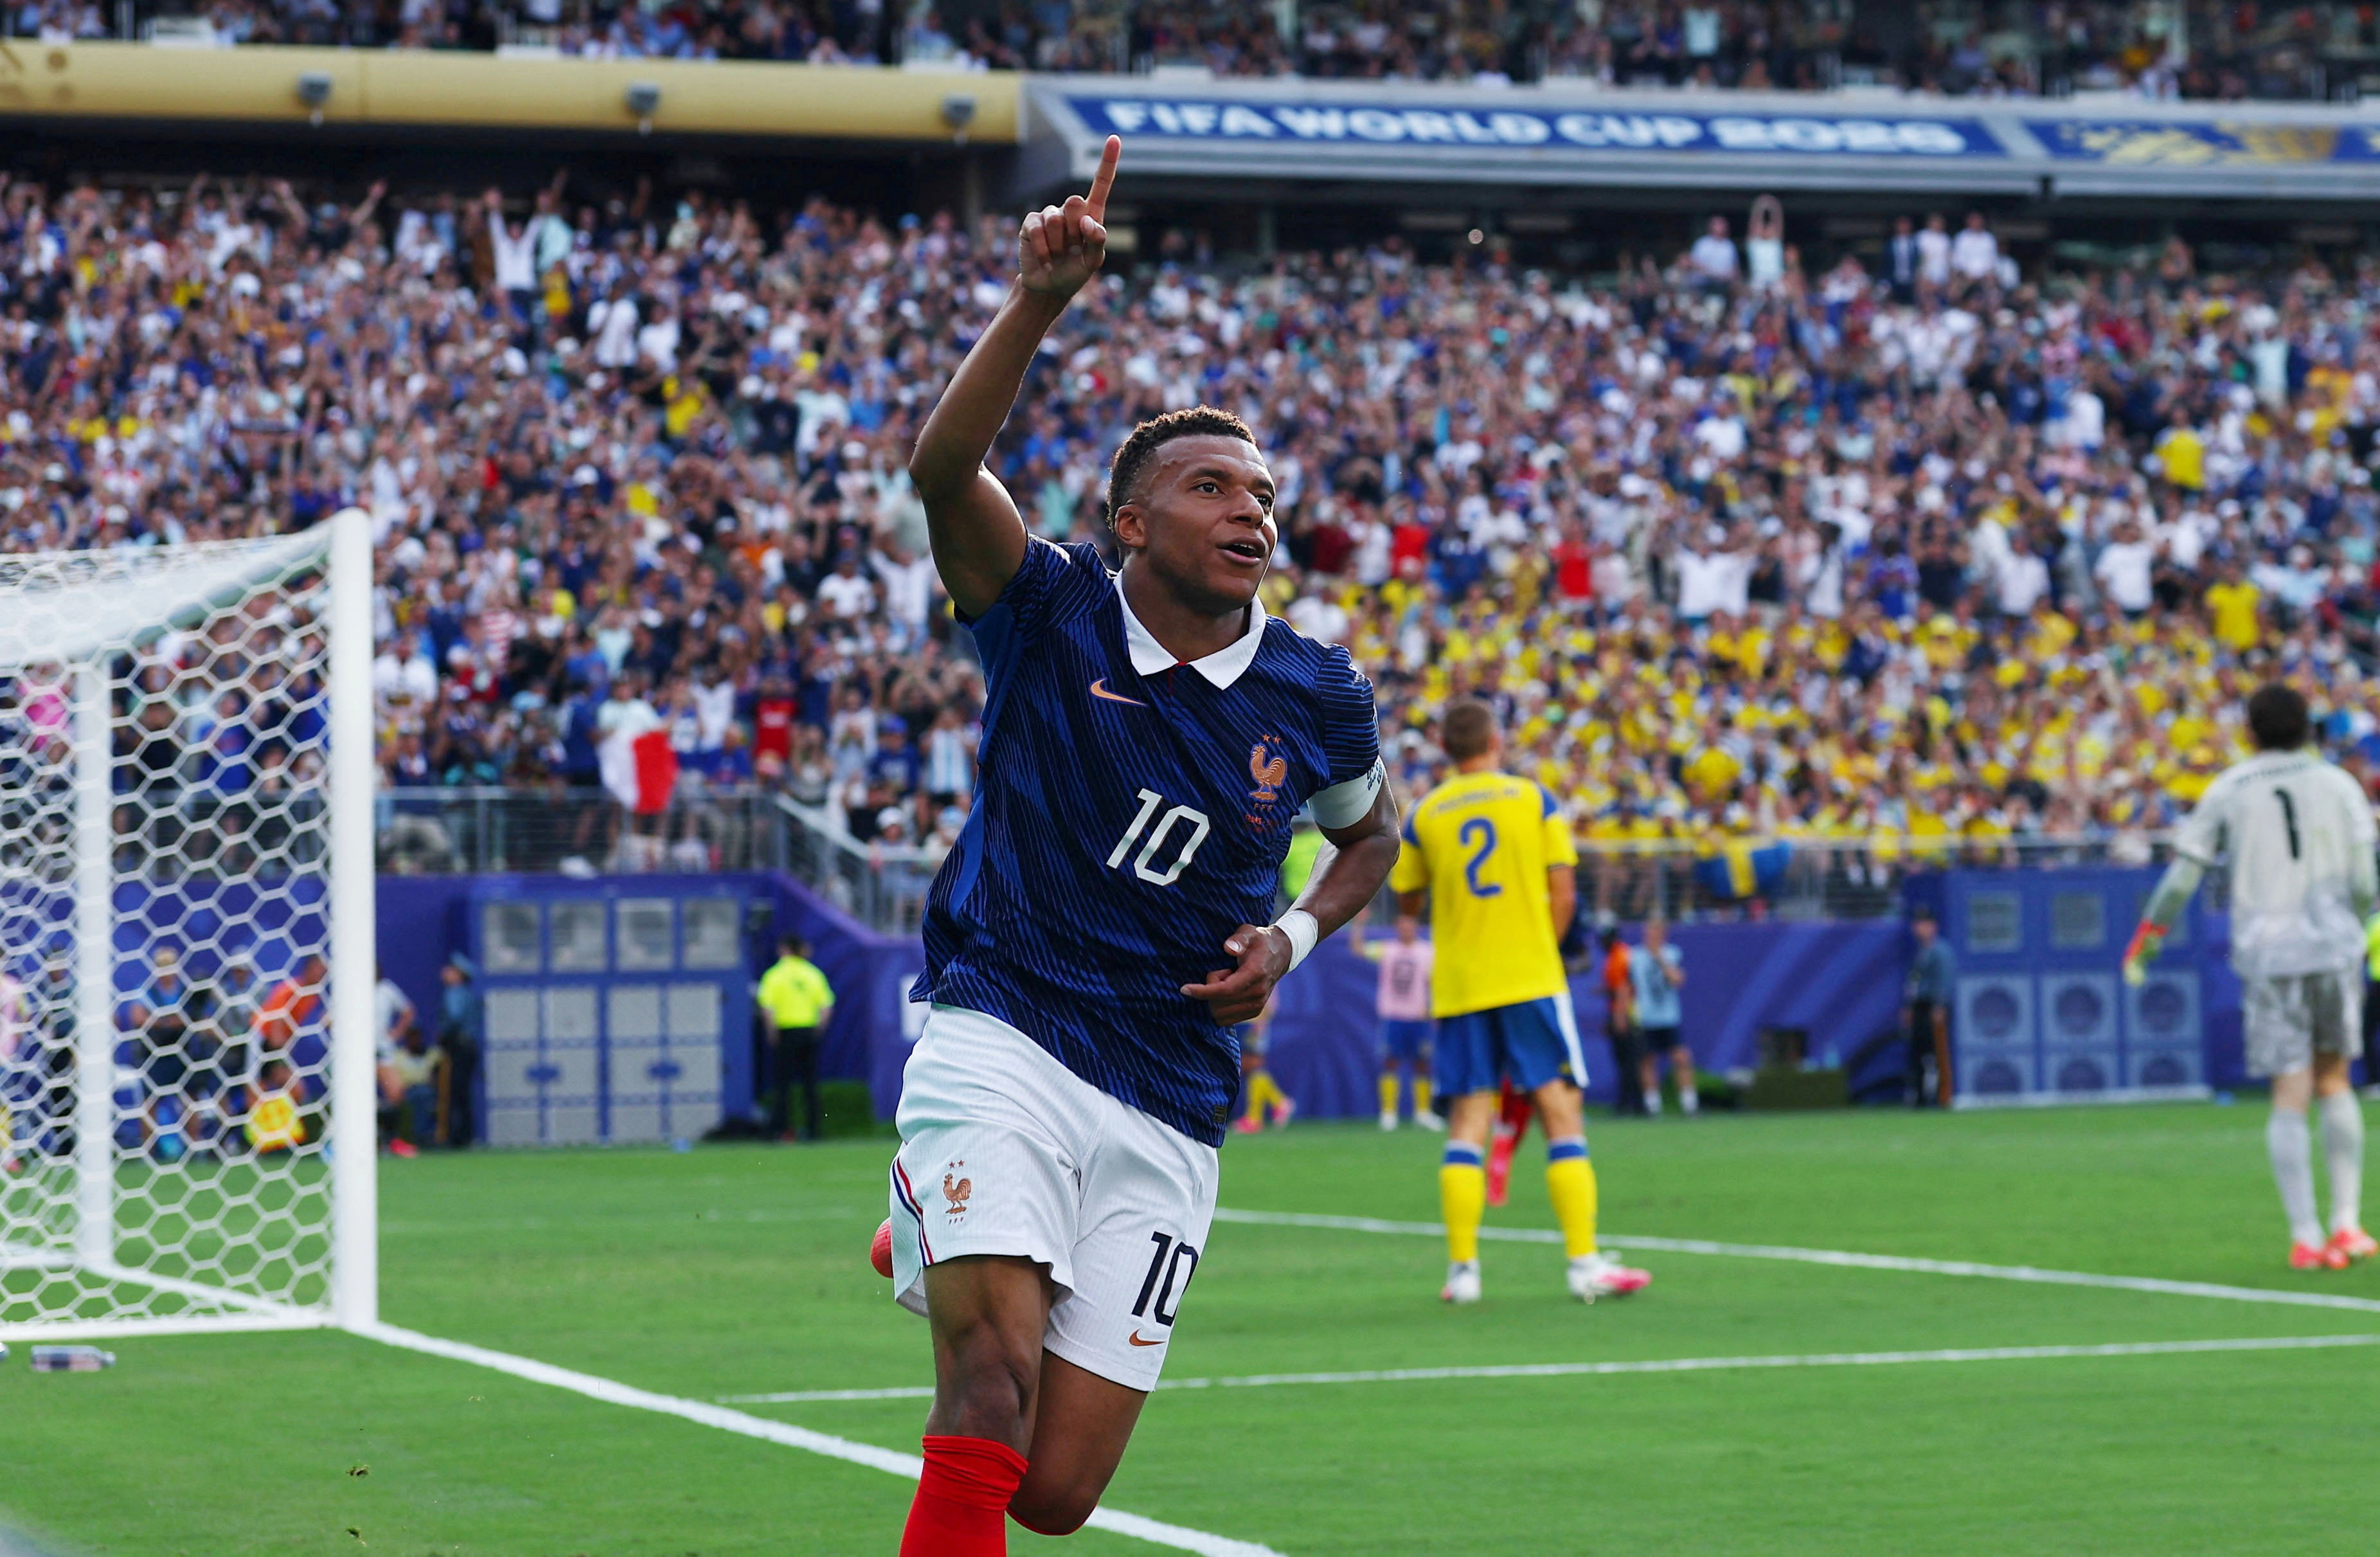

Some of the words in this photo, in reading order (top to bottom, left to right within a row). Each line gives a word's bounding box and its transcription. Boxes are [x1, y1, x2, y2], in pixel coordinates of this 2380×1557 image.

[1104, 101, 1277, 136] FIFA
[1275, 105, 1551, 145] WORLD
[1555, 112, 1702, 147] CUP
[1708, 116, 1967, 154] 2026
[1107, 788, 1210, 886] 10
[1458, 816, 1503, 899] 2
[2273, 786, 2301, 862] 1
[1131, 1230, 1199, 1327] 10
